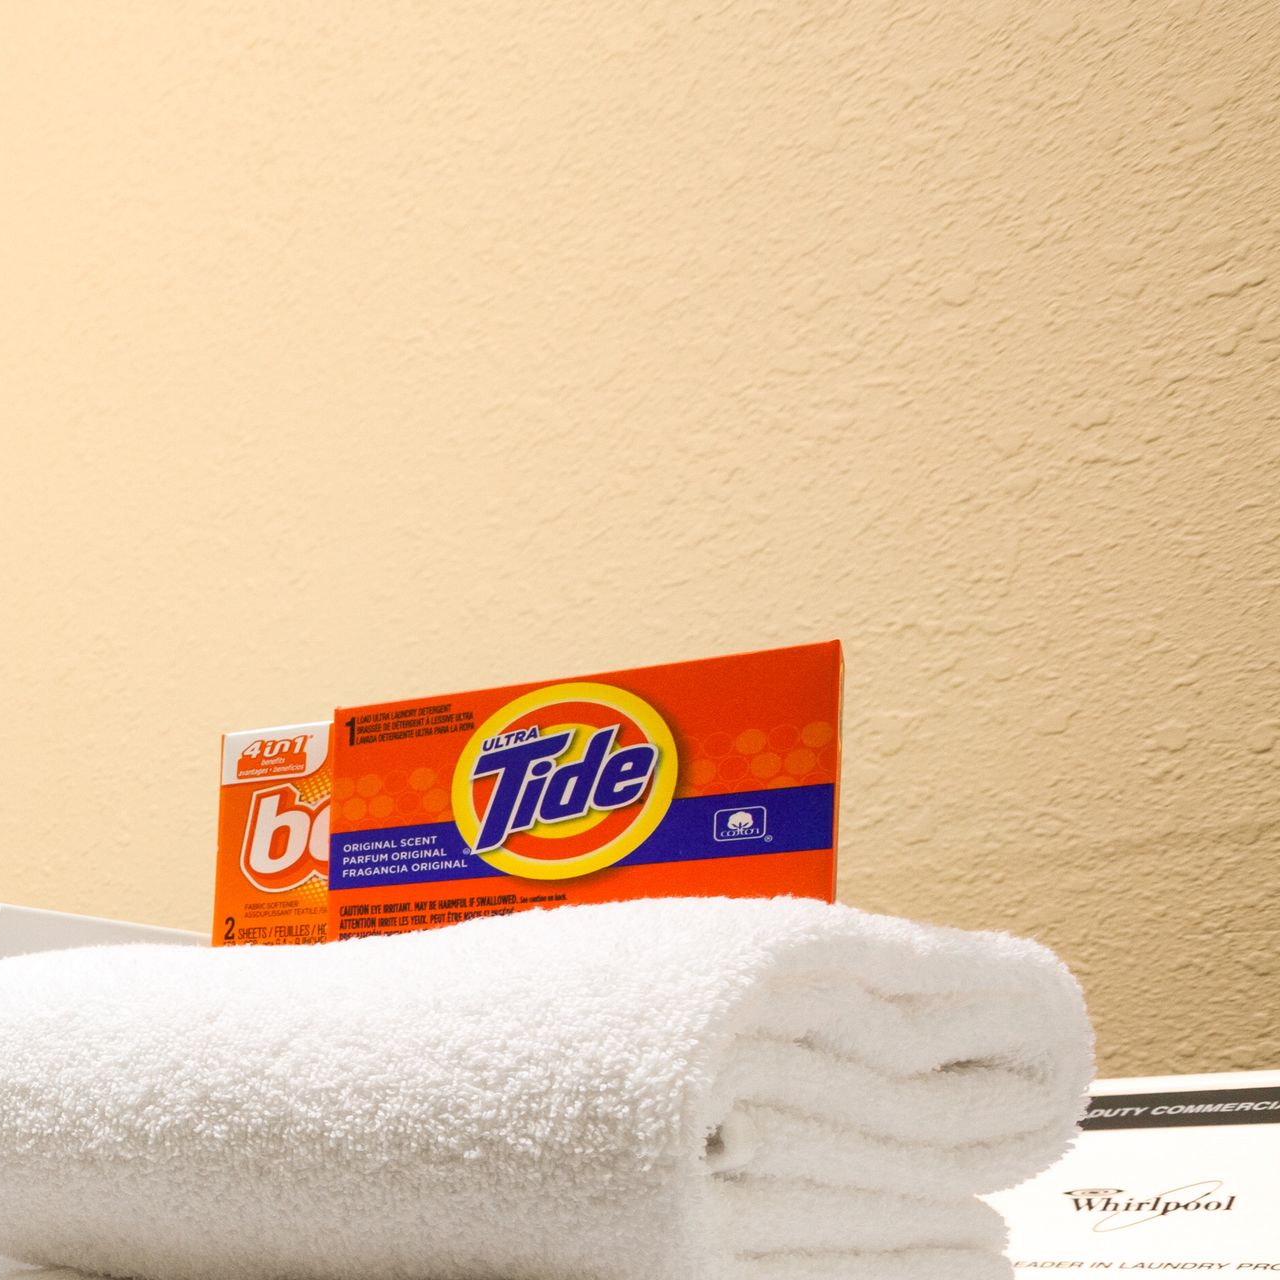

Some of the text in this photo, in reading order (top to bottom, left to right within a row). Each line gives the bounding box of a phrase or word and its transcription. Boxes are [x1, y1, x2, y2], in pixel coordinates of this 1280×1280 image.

[345, 717, 355, 746] 1
[482, 727, 538, 751] ULTRA
[242, 735, 307, 759] 4in1
[472, 725, 657, 854] Tide
[343, 836, 438, 853] ORIGINAL SCENT
[343, 848, 447, 865] PARFUM ORIGINAL
[342, 859, 468, 878] FRAGANCIA ORIGINAL
[414, 900, 427, 911] MAY
[429, 900, 437, 910] BE
[224, 916, 235, 940] 2
[238, 927, 267, 940] SHEETS
[275, 924, 310, 938] FEUILLES
[340, 918, 376, 930] ATTENTION
[1089, 1106, 1146, 1119] DUTY
[1072, 1196, 1237, 1216] Whirlpool
[1090, 1261, 1114, 1269] IN
[1118, 1262, 1231, 1271] LAUNDRY
